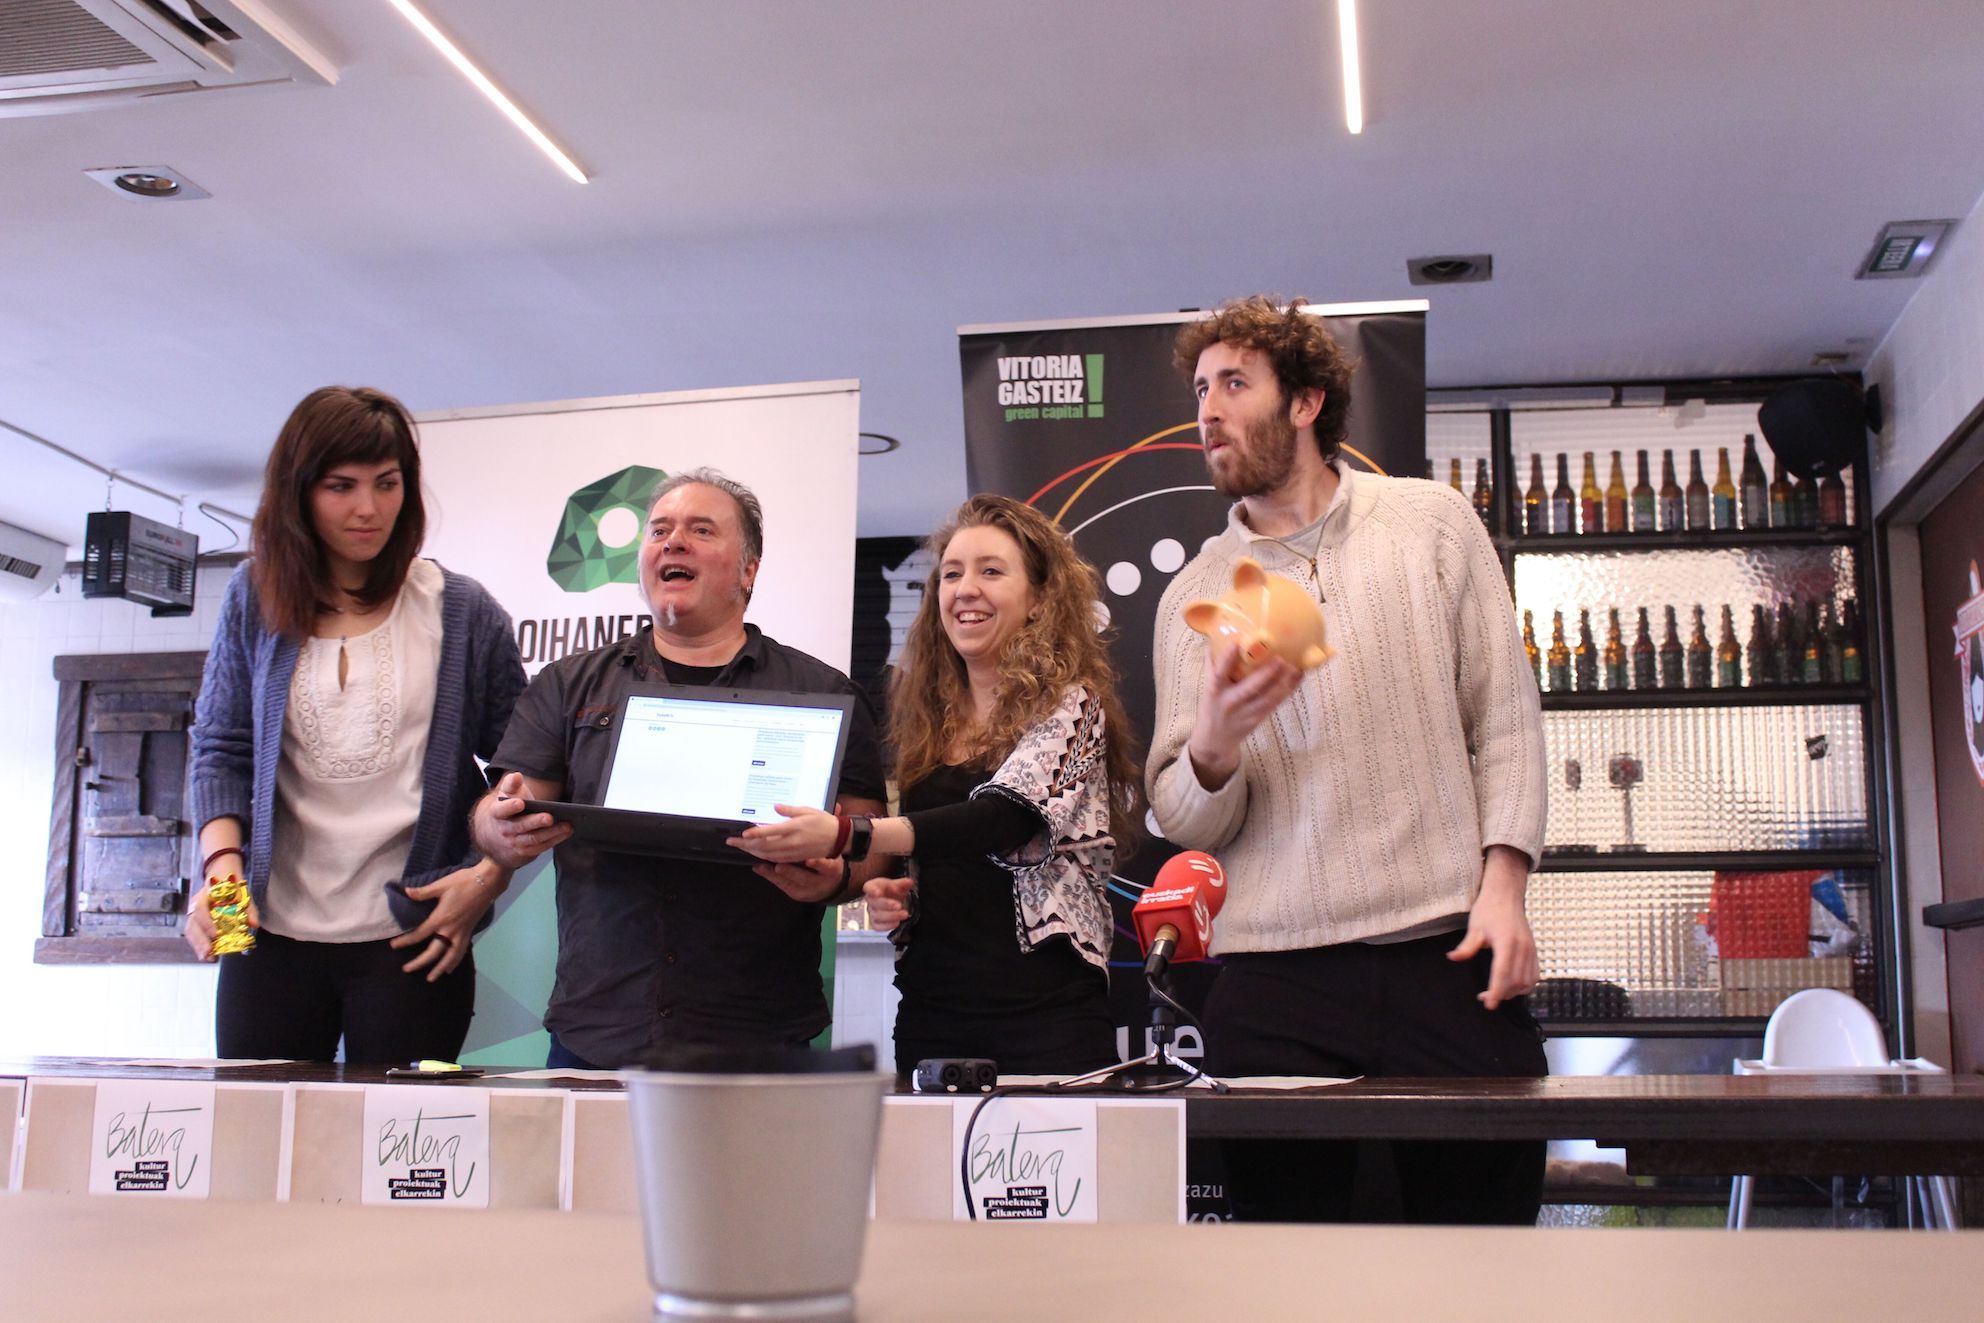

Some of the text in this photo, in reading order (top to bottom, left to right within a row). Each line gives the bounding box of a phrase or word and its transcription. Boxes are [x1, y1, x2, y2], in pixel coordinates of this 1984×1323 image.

[997, 354, 1084, 380] VITORIA
[998, 380, 1084, 406] GASTEIZ
[1005, 404, 1084, 422] green capital
[107, 1101, 202, 1190] Batera
[379, 1107, 477, 1198] Batera
[139, 1161, 165, 1170] kultur
[971, 1120, 1083, 1217] Batera
[118, 1171, 164, 1180] proiektuak
[414, 1169, 443, 1179] kultur
[120, 1180, 165, 1189] elkarrekin
[393, 1179, 442, 1189] proiektuak
[395, 1189, 442, 1198] elkarrekin
[1012, 1187, 1044, 1196] kultur
[988, 1198, 1042, 1208] proiektuak
[991, 1208, 1043, 1218] elkarrekin
